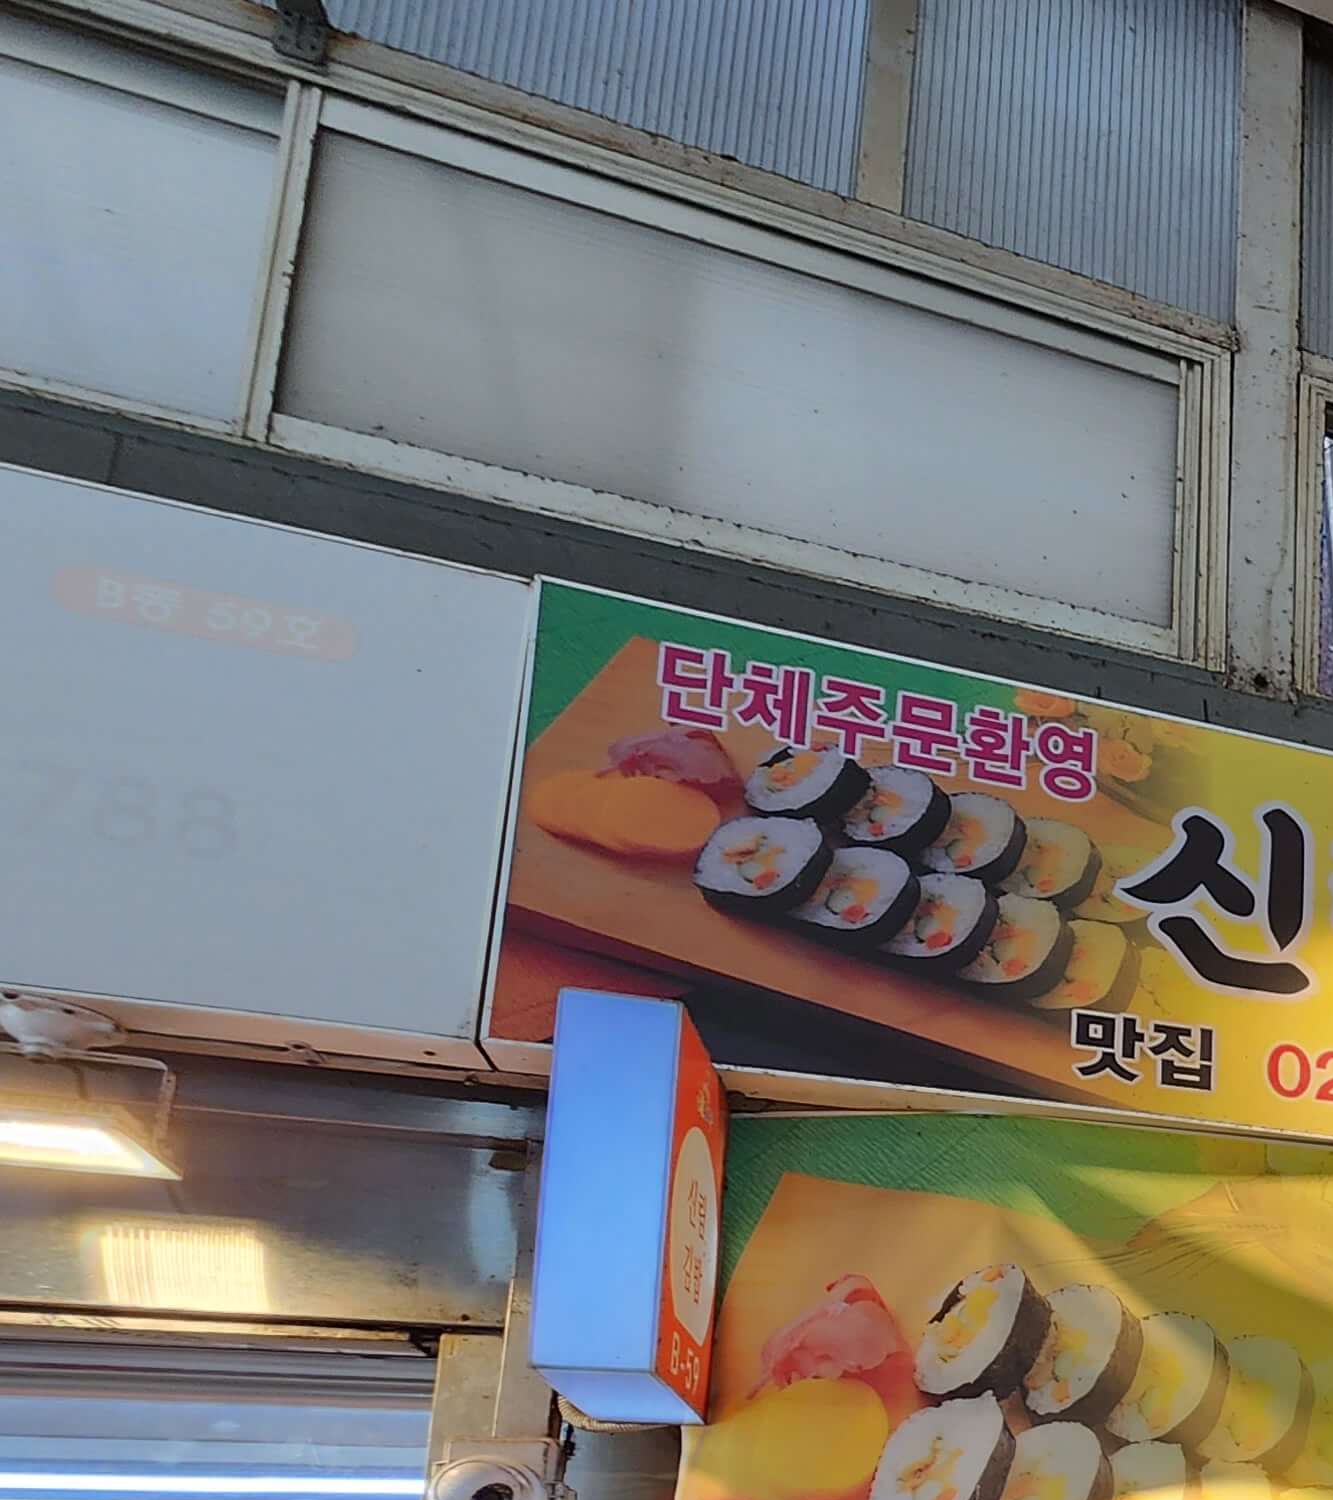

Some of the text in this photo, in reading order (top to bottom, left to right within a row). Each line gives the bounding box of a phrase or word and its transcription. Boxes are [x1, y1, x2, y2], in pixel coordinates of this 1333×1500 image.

[657, 641, 1098, 800] 단체주문환영
[1072, 1010, 1215, 1090] 맛집
[669, 1331, 702, 1394] B-59
